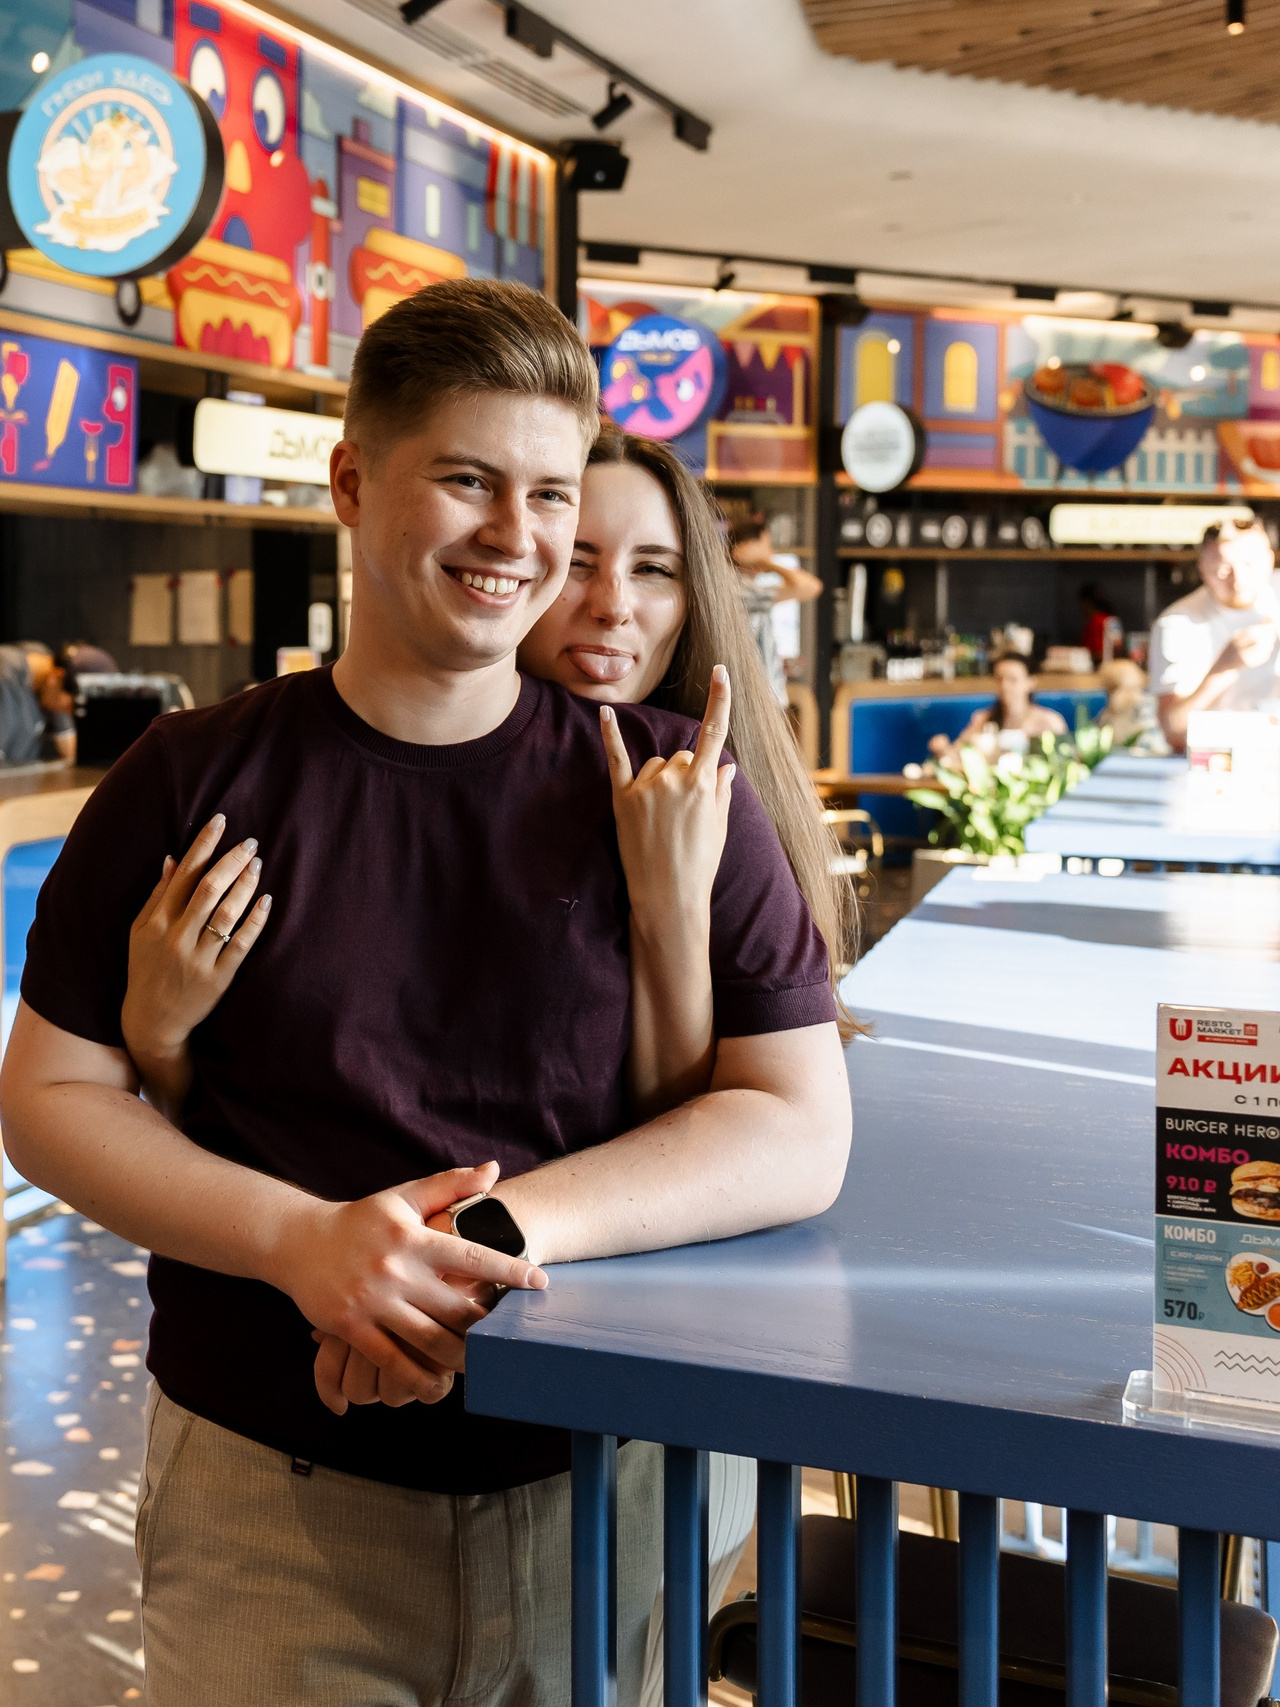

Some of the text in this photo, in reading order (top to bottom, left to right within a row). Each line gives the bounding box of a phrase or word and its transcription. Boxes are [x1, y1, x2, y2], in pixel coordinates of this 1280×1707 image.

[1196, 1019, 1233, 1028] RESTO
[1196, 1026, 1242, 1036] MARKET
[1253, 1096, 1260, 1106] 1
[1165, 1117, 1280, 1140] BURGER HERO
[1165, 1142, 1251, 1166] КОМБО
[1166, 1175, 1200, 1192] 910
[1164, 1224, 1217, 1245] КОМБО
